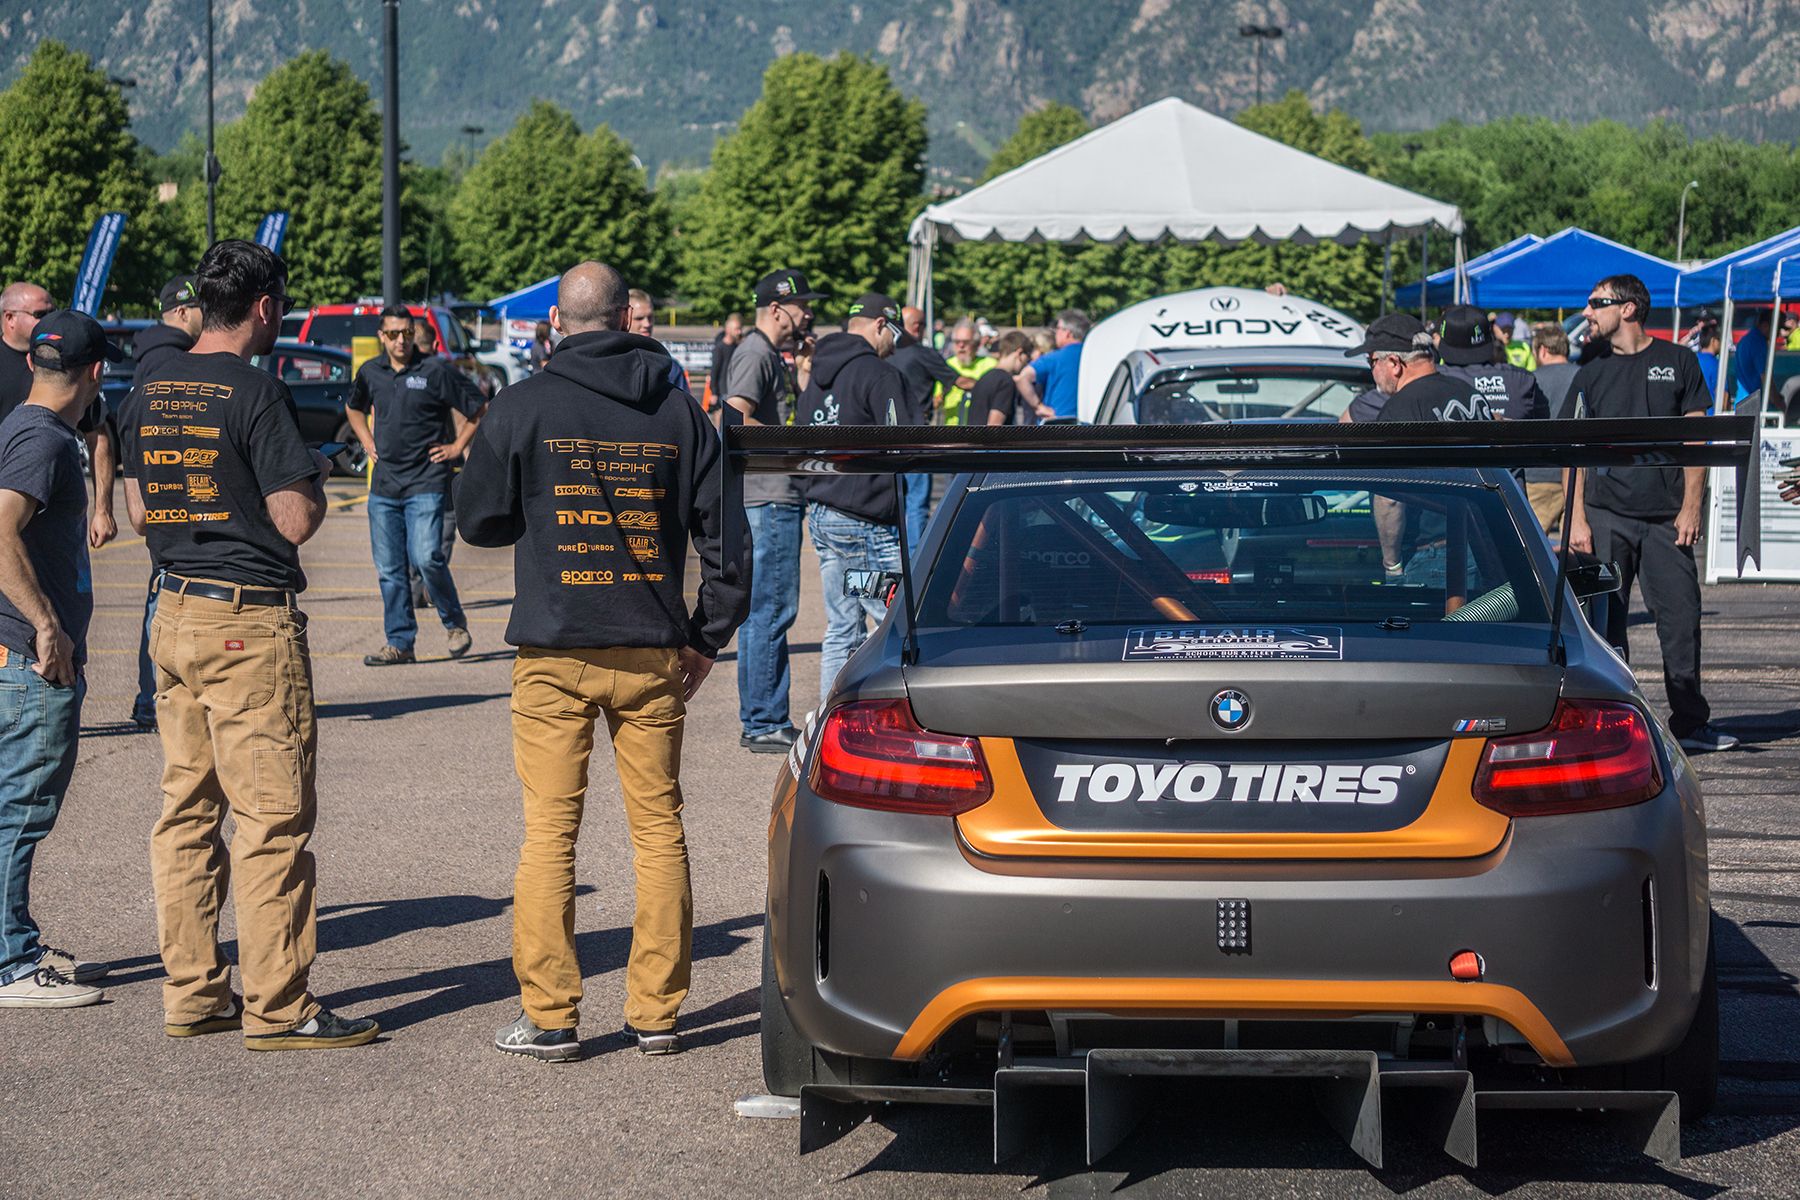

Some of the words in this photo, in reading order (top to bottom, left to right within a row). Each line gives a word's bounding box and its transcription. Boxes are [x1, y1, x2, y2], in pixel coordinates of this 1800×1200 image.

[1150, 319, 1302, 337] ACURA
[150, 400, 179, 410] 2019
[570, 459, 607, 472] 209
[609, 462, 655, 473] PPIHC
[145, 508, 188, 524] parco
[616, 510, 660, 526] APE
[558, 544, 577, 552] PURE
[626, 537, 649, 548] ELAIR
[561, 570, 614, 585] sparco
[1154, 629, 1276, 640] BELAIR
[1214, 690, 1248, 705] BMW
[1053, 763, 1222, 803] TOYO
[1227, 764, 1402, 804] TIRES
